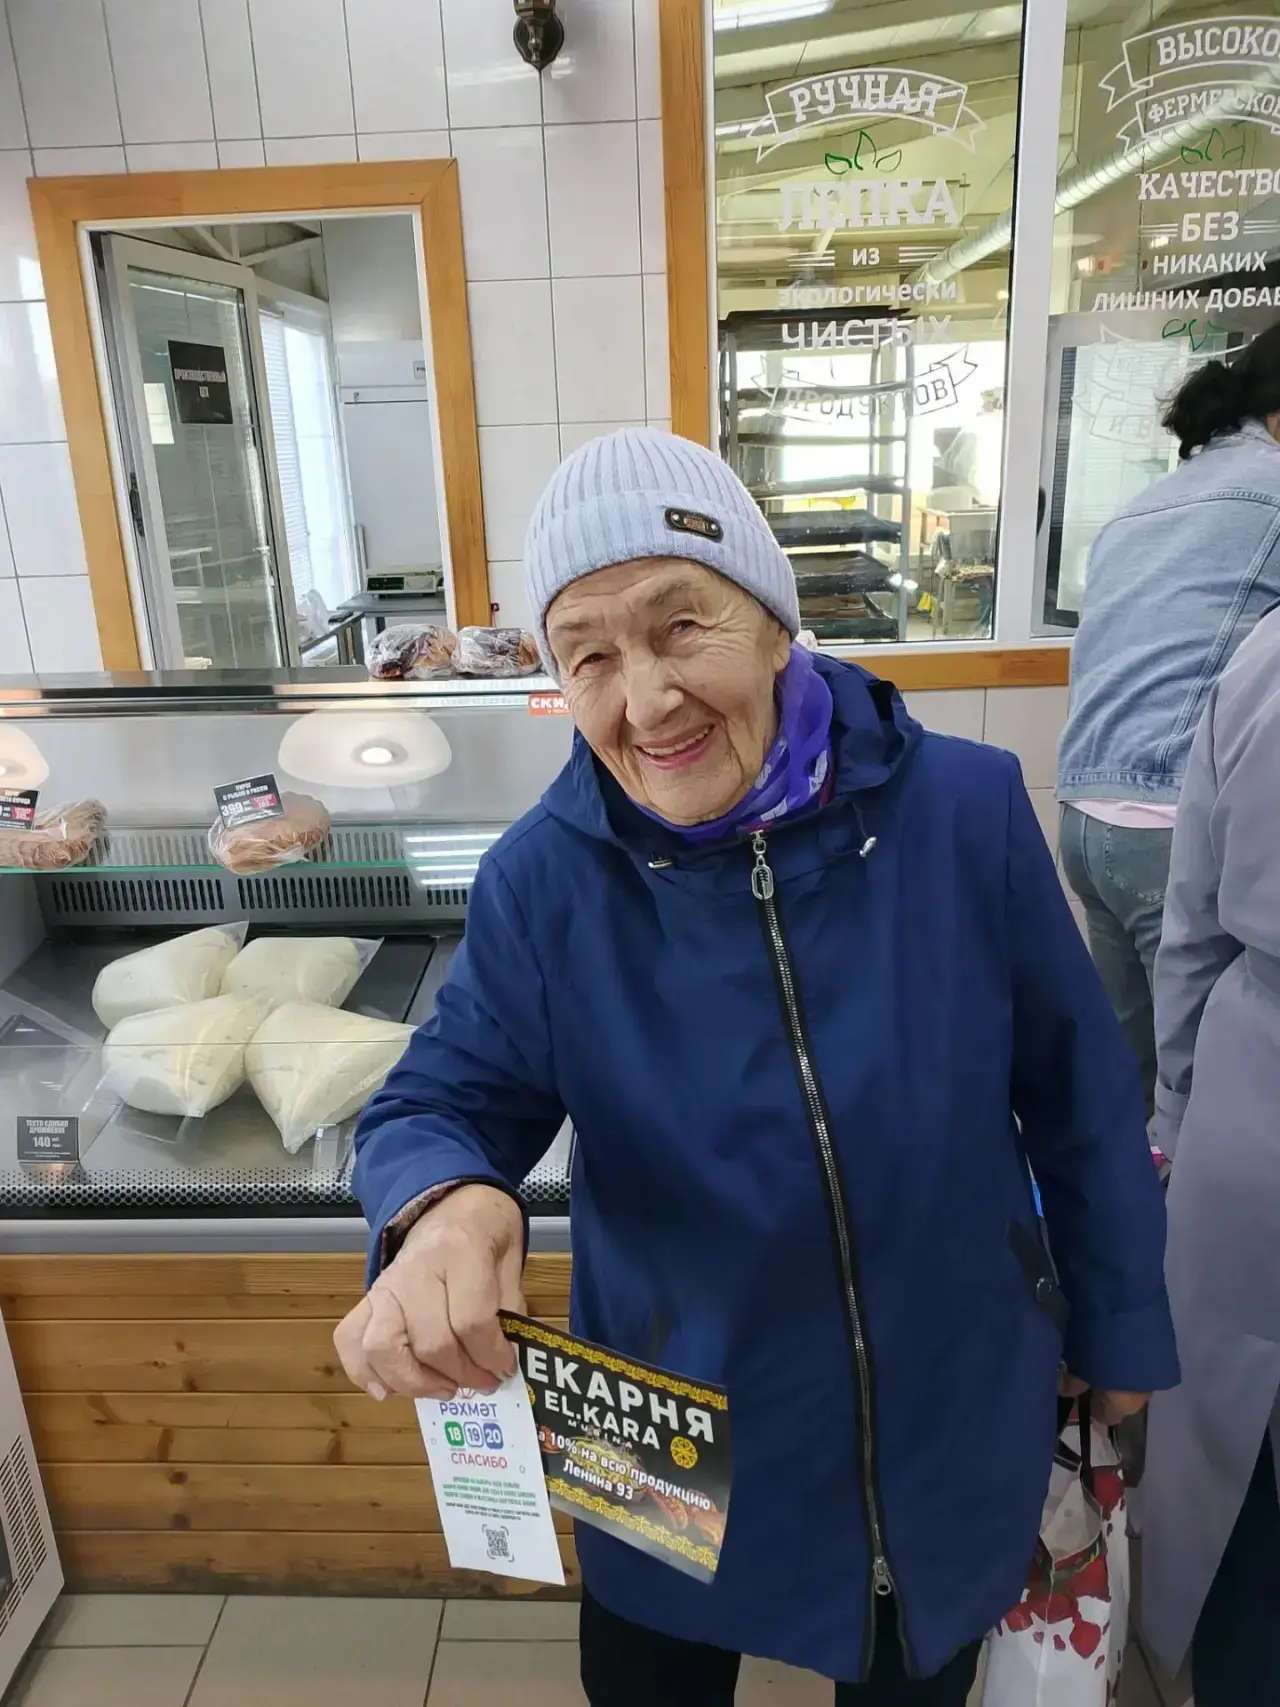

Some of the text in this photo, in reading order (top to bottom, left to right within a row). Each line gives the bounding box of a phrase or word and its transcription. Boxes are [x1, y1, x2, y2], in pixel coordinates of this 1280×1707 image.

[1157, 26, 1280, 66] ВЫСОКО
[789, 74, 942, 122] РУЧНАЯ
[778, 177, 960, 231] ЛЕПКА
[1181, 211, 1240, 242] БЕЗ
[852, 247, 880, 266] ИЗ
[1153, 251, 1268, 275] НИКАКИХ
[778, 279, 957, 309] экологически
[1090, 289, 1200, 313] ЛИШНИХ
[781, 315, 952, 351] ЧИСТЫХ
[530, 697, 569, 709] СКИ
[221, 802, 243, 817] 399
[33, 1136, 51, 1148] 140
[440, 1402, 498, 1418] РӘХМӘТ
[544, 1389, 661, 1450] EL.KARA
[447, 1426, 501, 1444] 18 19 20
[450, 1452, 508, 1469] СПАСИБО
[550, 1432, 577, 1455] 10%
[581, 1448, 597, 1463] на
[600, 1455, 627, 1476] всю
[630, 1467, 711, 1511] продукцию
[563, 1459, 613, 1493] Ленина
[616, 1484, 634, 1501] 93
